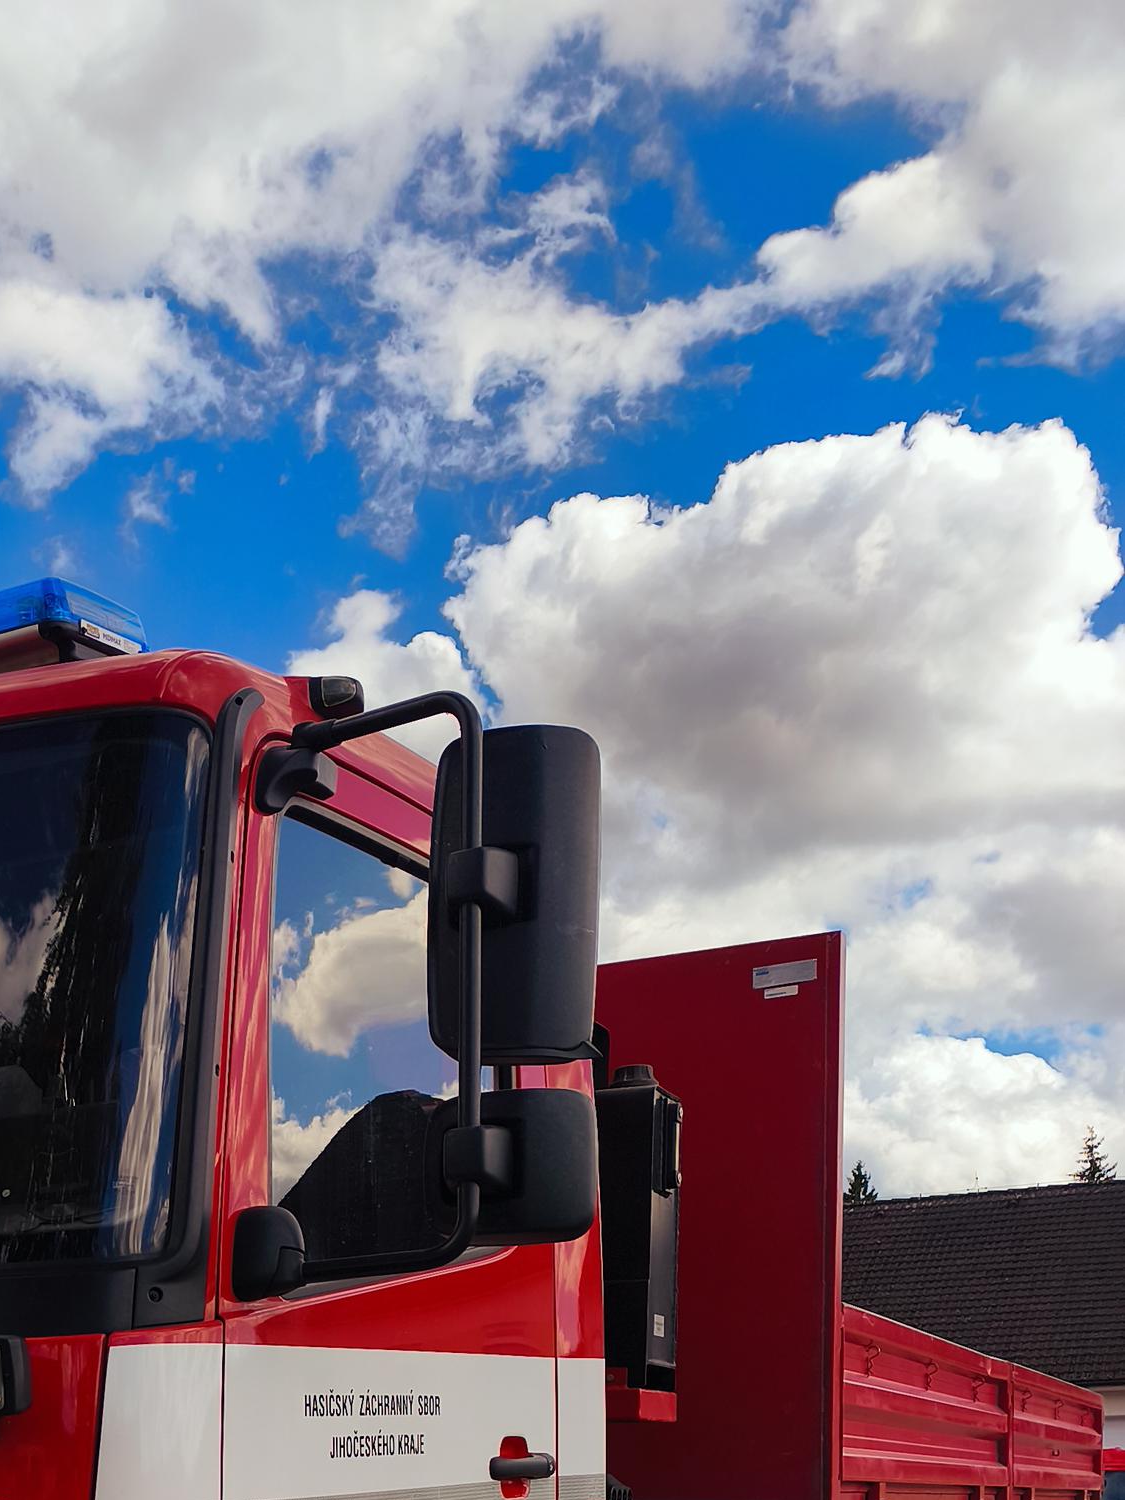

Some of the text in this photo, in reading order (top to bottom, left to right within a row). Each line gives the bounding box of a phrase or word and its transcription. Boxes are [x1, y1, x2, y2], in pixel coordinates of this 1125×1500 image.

[304, 1389, 441, 1417] HASIČSKÝ ZÁCHRANNÝ SBOR
[330, 1429, 424, 1458] JIHOČESKÉHO KRAJE
